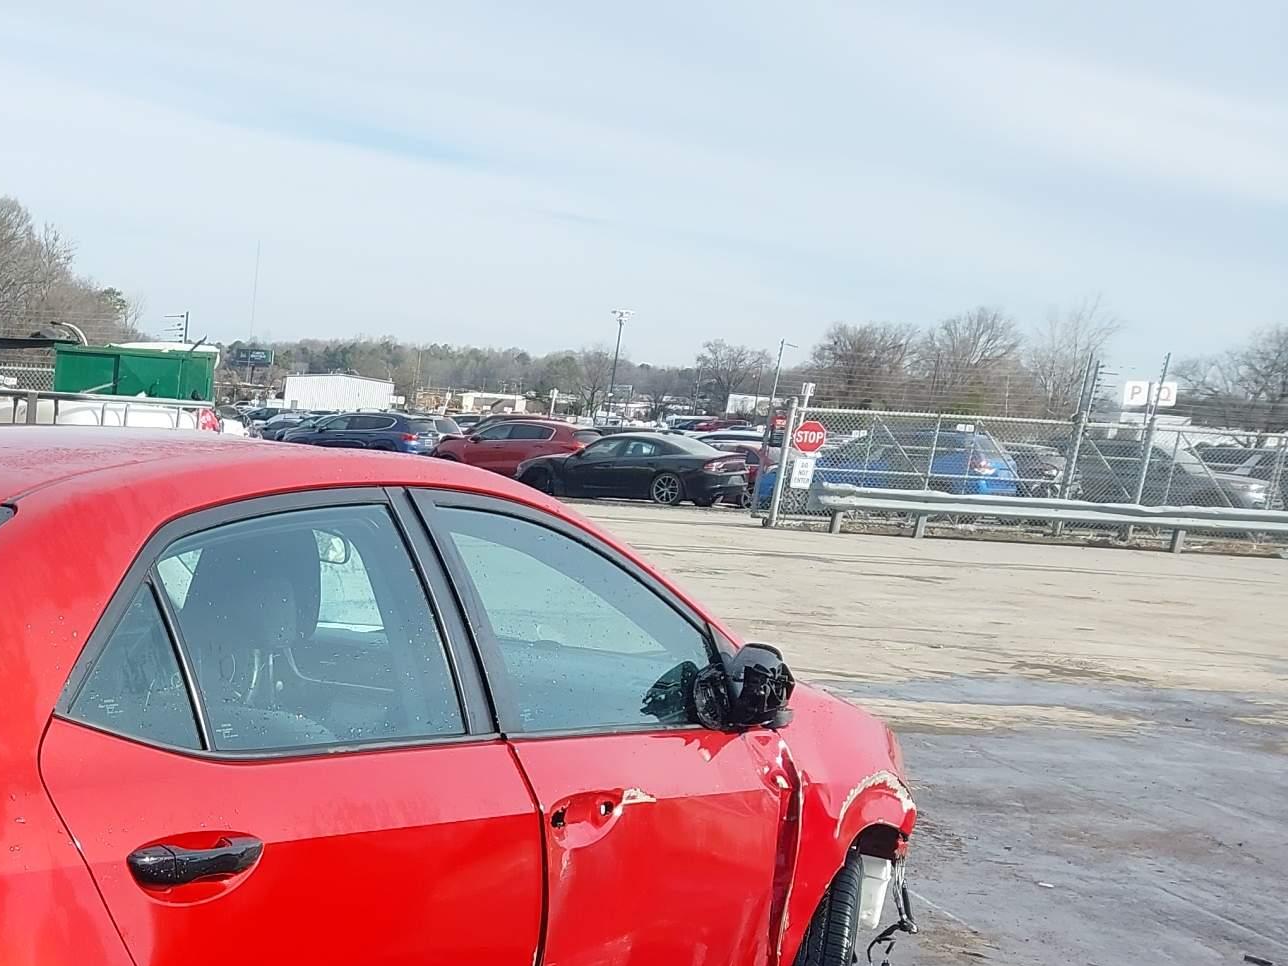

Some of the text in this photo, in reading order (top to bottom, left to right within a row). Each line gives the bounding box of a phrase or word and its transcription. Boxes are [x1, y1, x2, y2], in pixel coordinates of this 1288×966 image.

[1130, 385, 1171, 402] P Q
[796, 430, 824, 444] STOP
